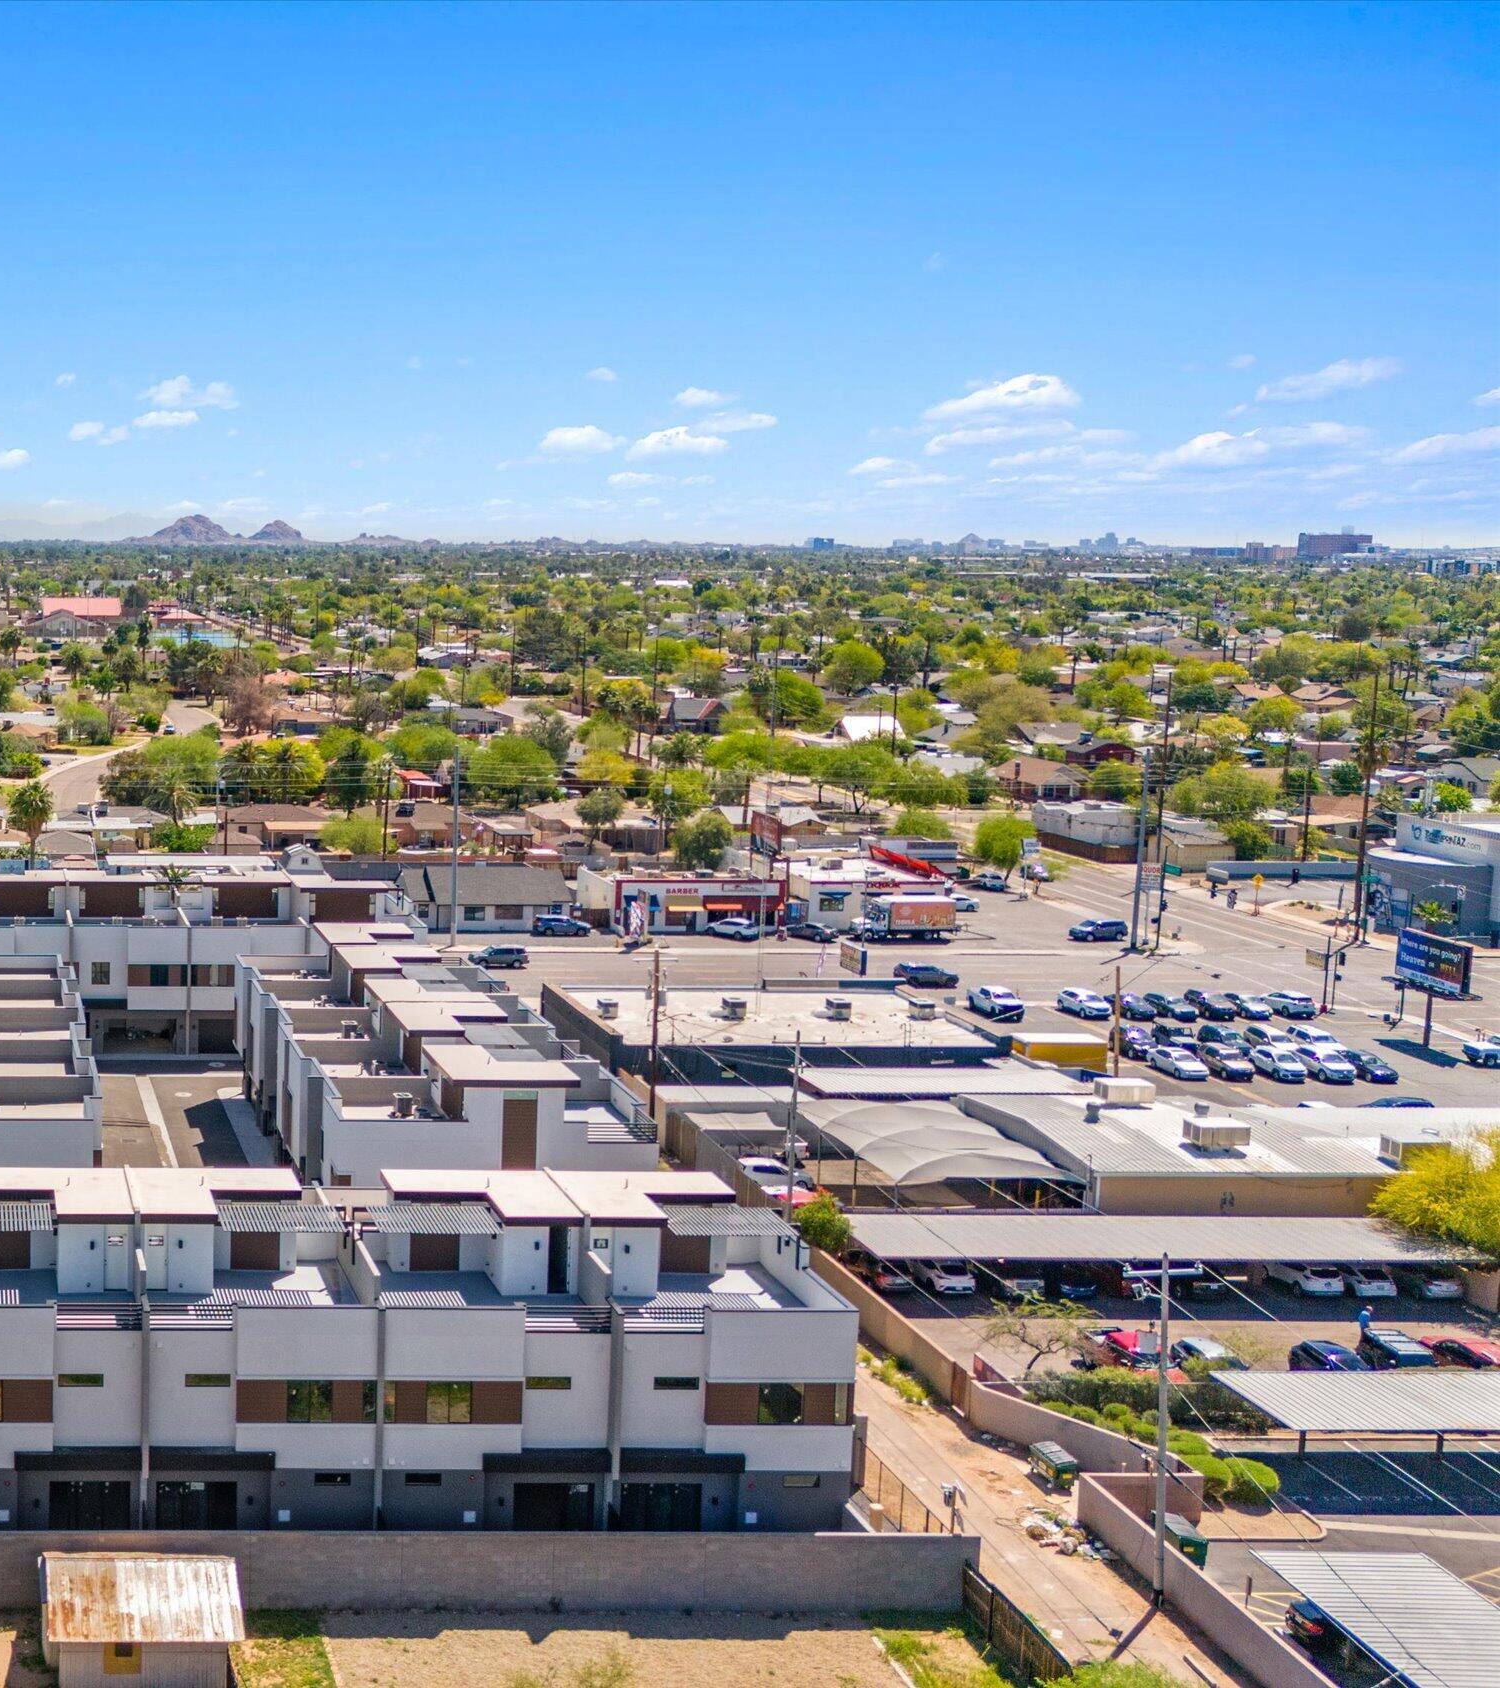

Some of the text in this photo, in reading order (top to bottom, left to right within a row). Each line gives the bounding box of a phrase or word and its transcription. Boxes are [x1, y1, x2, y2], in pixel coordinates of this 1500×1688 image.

[1401, 938, 1461, 963] Where are you going?
[1401, 951, 1425, 967] Heaven
